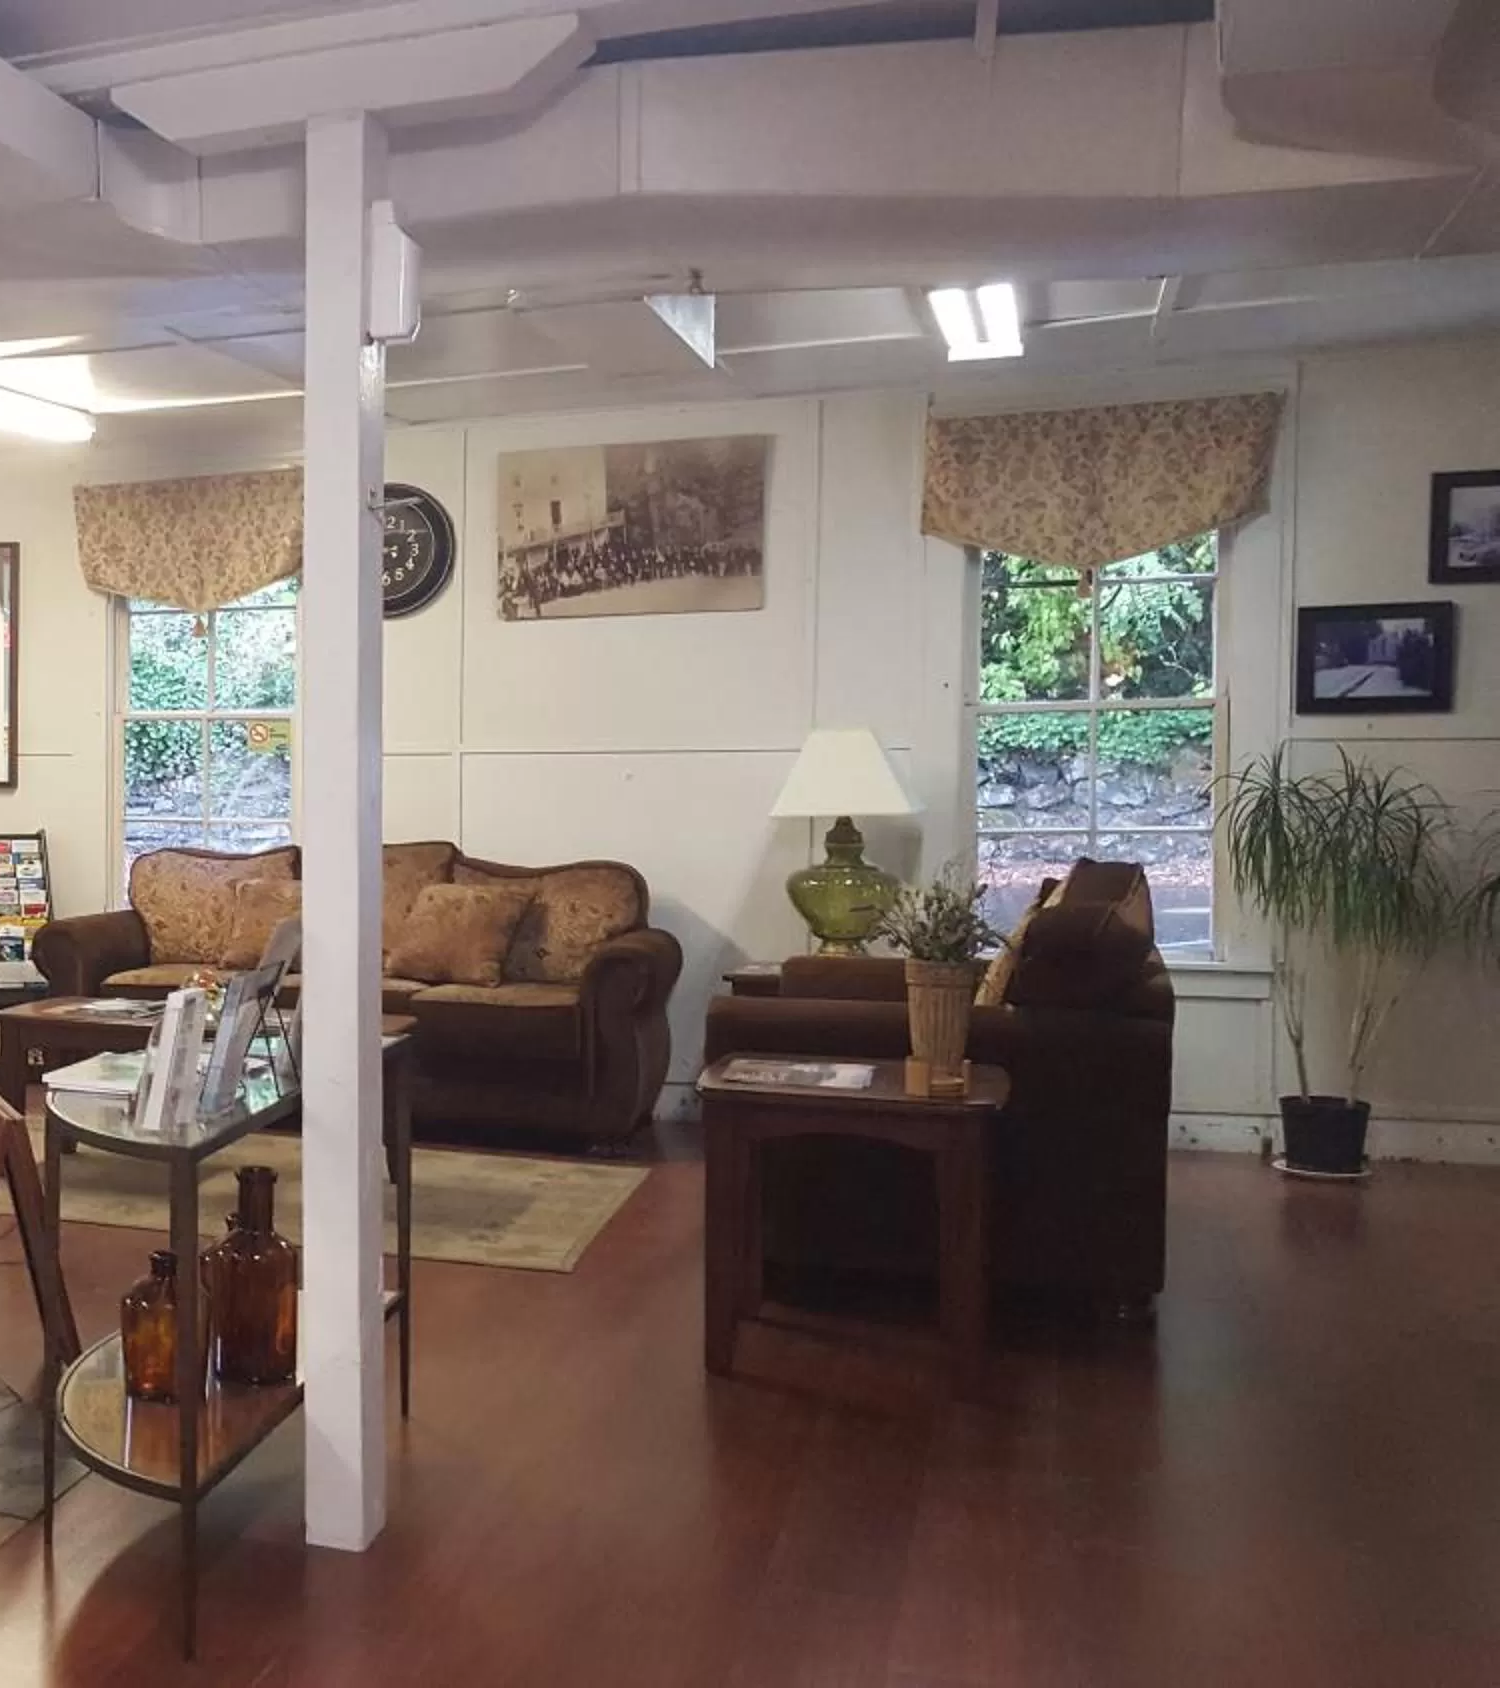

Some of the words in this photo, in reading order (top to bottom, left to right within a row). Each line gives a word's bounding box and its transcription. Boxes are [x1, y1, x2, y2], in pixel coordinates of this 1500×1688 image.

[407, 529, 417, 542] 2
[411, 543, 420, 557] 3
[405, 557, 415, 571] 4
[381, 572, 392, 586] 6
[395, 567, 405, 581] 5
